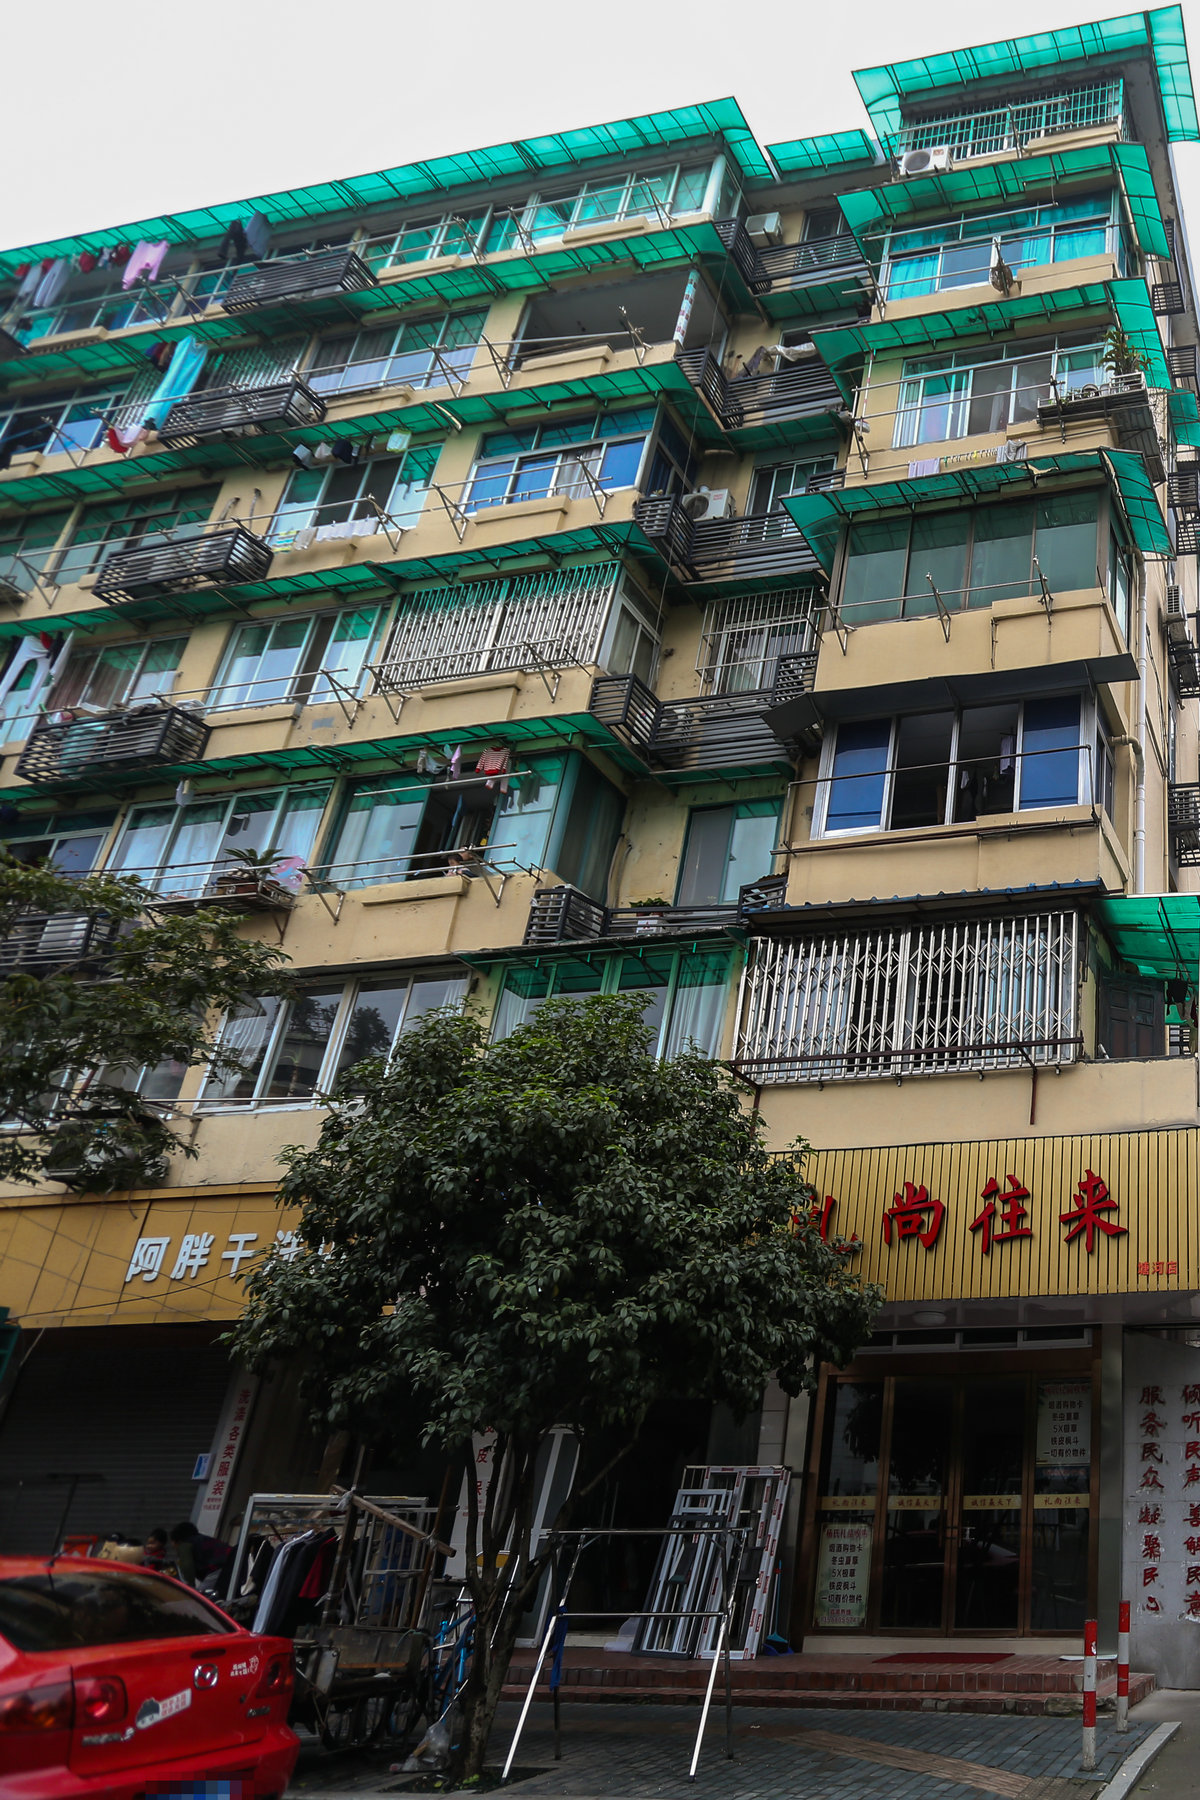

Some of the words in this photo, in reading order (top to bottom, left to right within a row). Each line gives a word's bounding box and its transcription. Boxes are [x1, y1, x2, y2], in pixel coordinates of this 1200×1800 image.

[125, 1232, 346, 1283] 阿胖干洗
[1136, 1261, 1178, 1276] 塘河店
